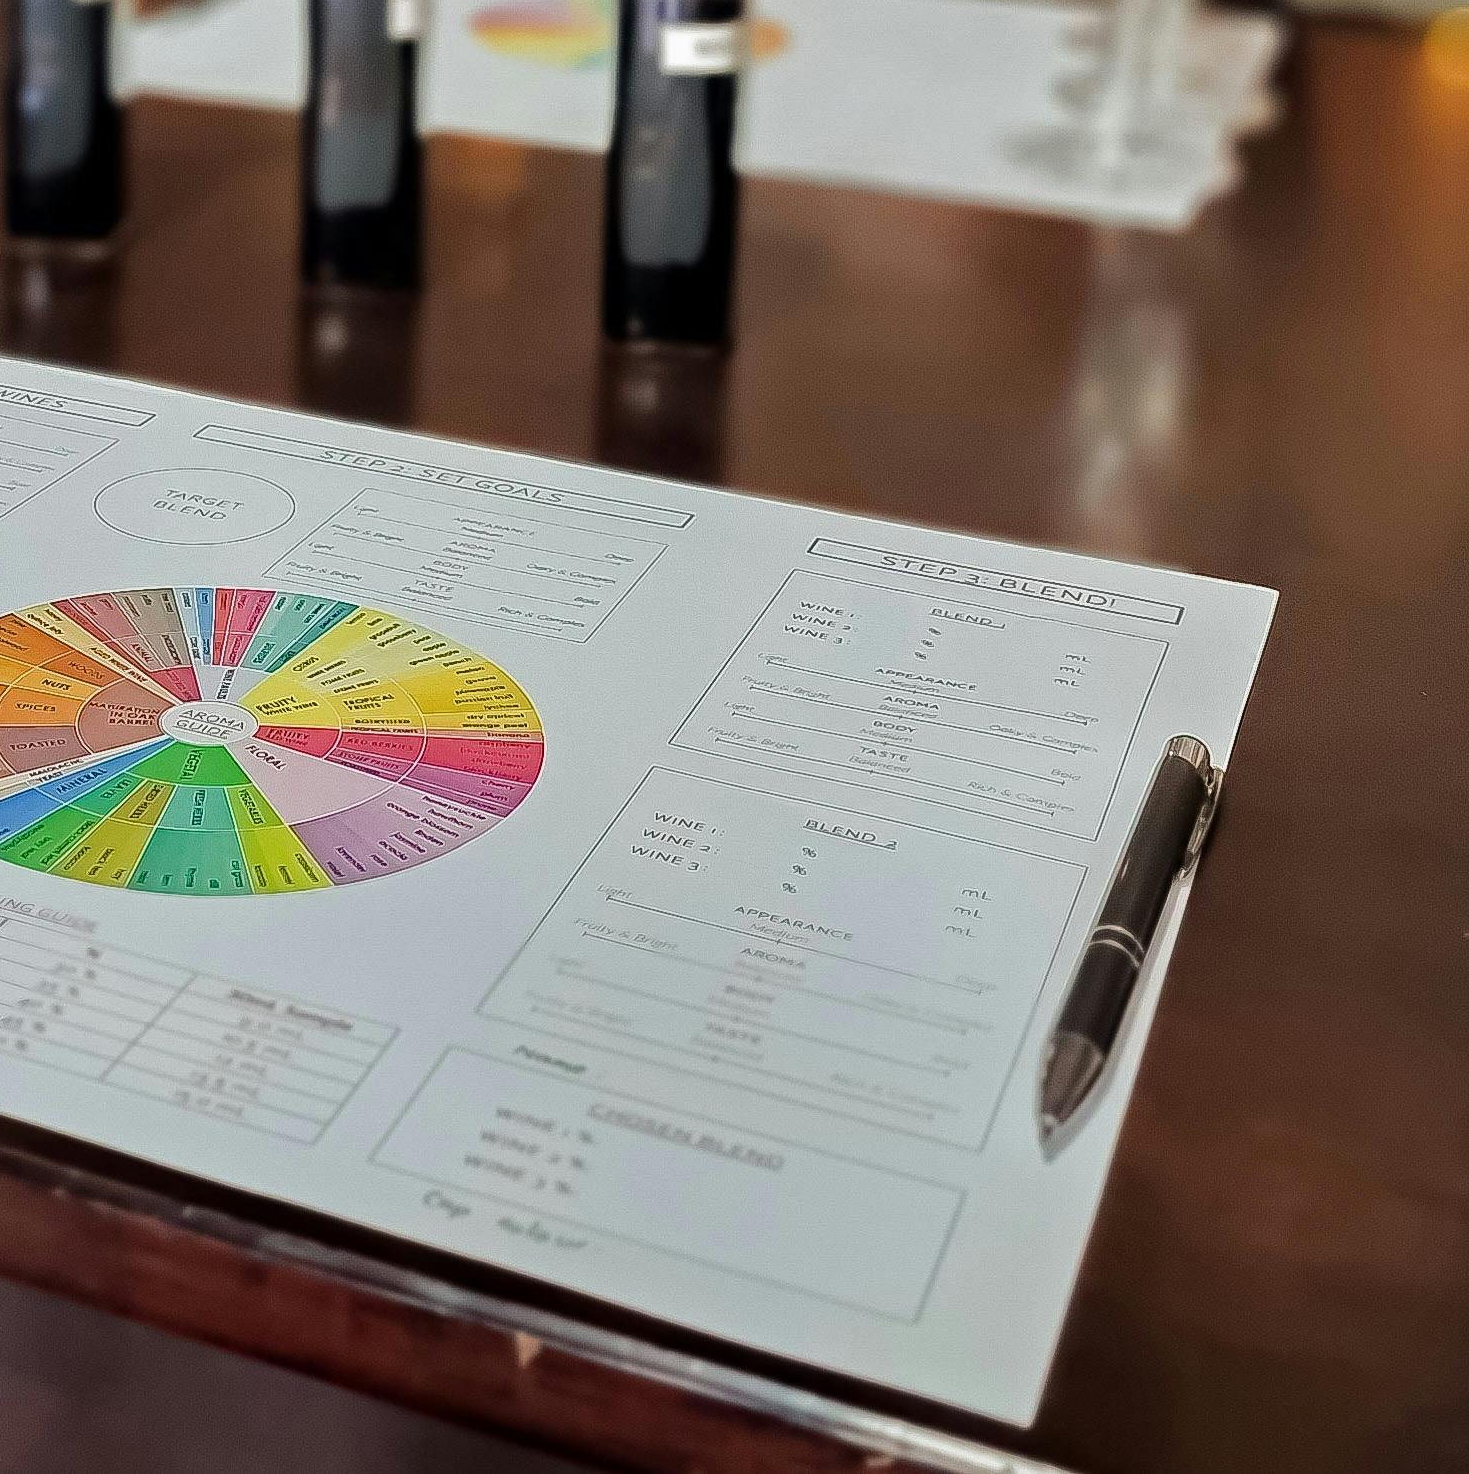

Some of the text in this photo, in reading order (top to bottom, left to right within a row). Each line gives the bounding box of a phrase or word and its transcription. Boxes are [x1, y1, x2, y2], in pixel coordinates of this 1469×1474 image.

[319, 449, 387, 471] STEP
[419, 468, 469, 488] SET
[474, 479, 566, 504] GOALS
[166, 489, 245, 511] TARGET
[152, 500, 228, 521] BLEND
[881, 555, 958, 577] STEP
[800, 600, 845, 617] WINE
[931, 608, 994, 627] BLEND
[792, 612, 837, 628] WINE
[784, 624, 830, 641] WINE
[41, 678, 72, 691] NUTS
[875, 667, 978, 692] APPEARANCE
[14, 702, 57, 713] SPICES
[255, 696, 298, 713] FRUITY
[343, 693, 395, 706] TROPICAL
[883, 695, 940, 711] AROMA
[176, 718, 235, 740] GUIDE
[182, 709, 245, 731] AROMA
[872, 719, 918, 735] BODY
[8, 738, 67, 752] TOASTED
[859, 744, 910, 763] TASTE
[244, 744, 288, 771] FLORAL
[654, 812, 706, 832] WINE
[804, 818, 878, 843] BLEND
[642, 828, 696, 849] WINE
[631, 845, 685, 866] WINE
[734, 905, 854, 942] APPEARANCE
[740, 947, 807, 968] AROMA
